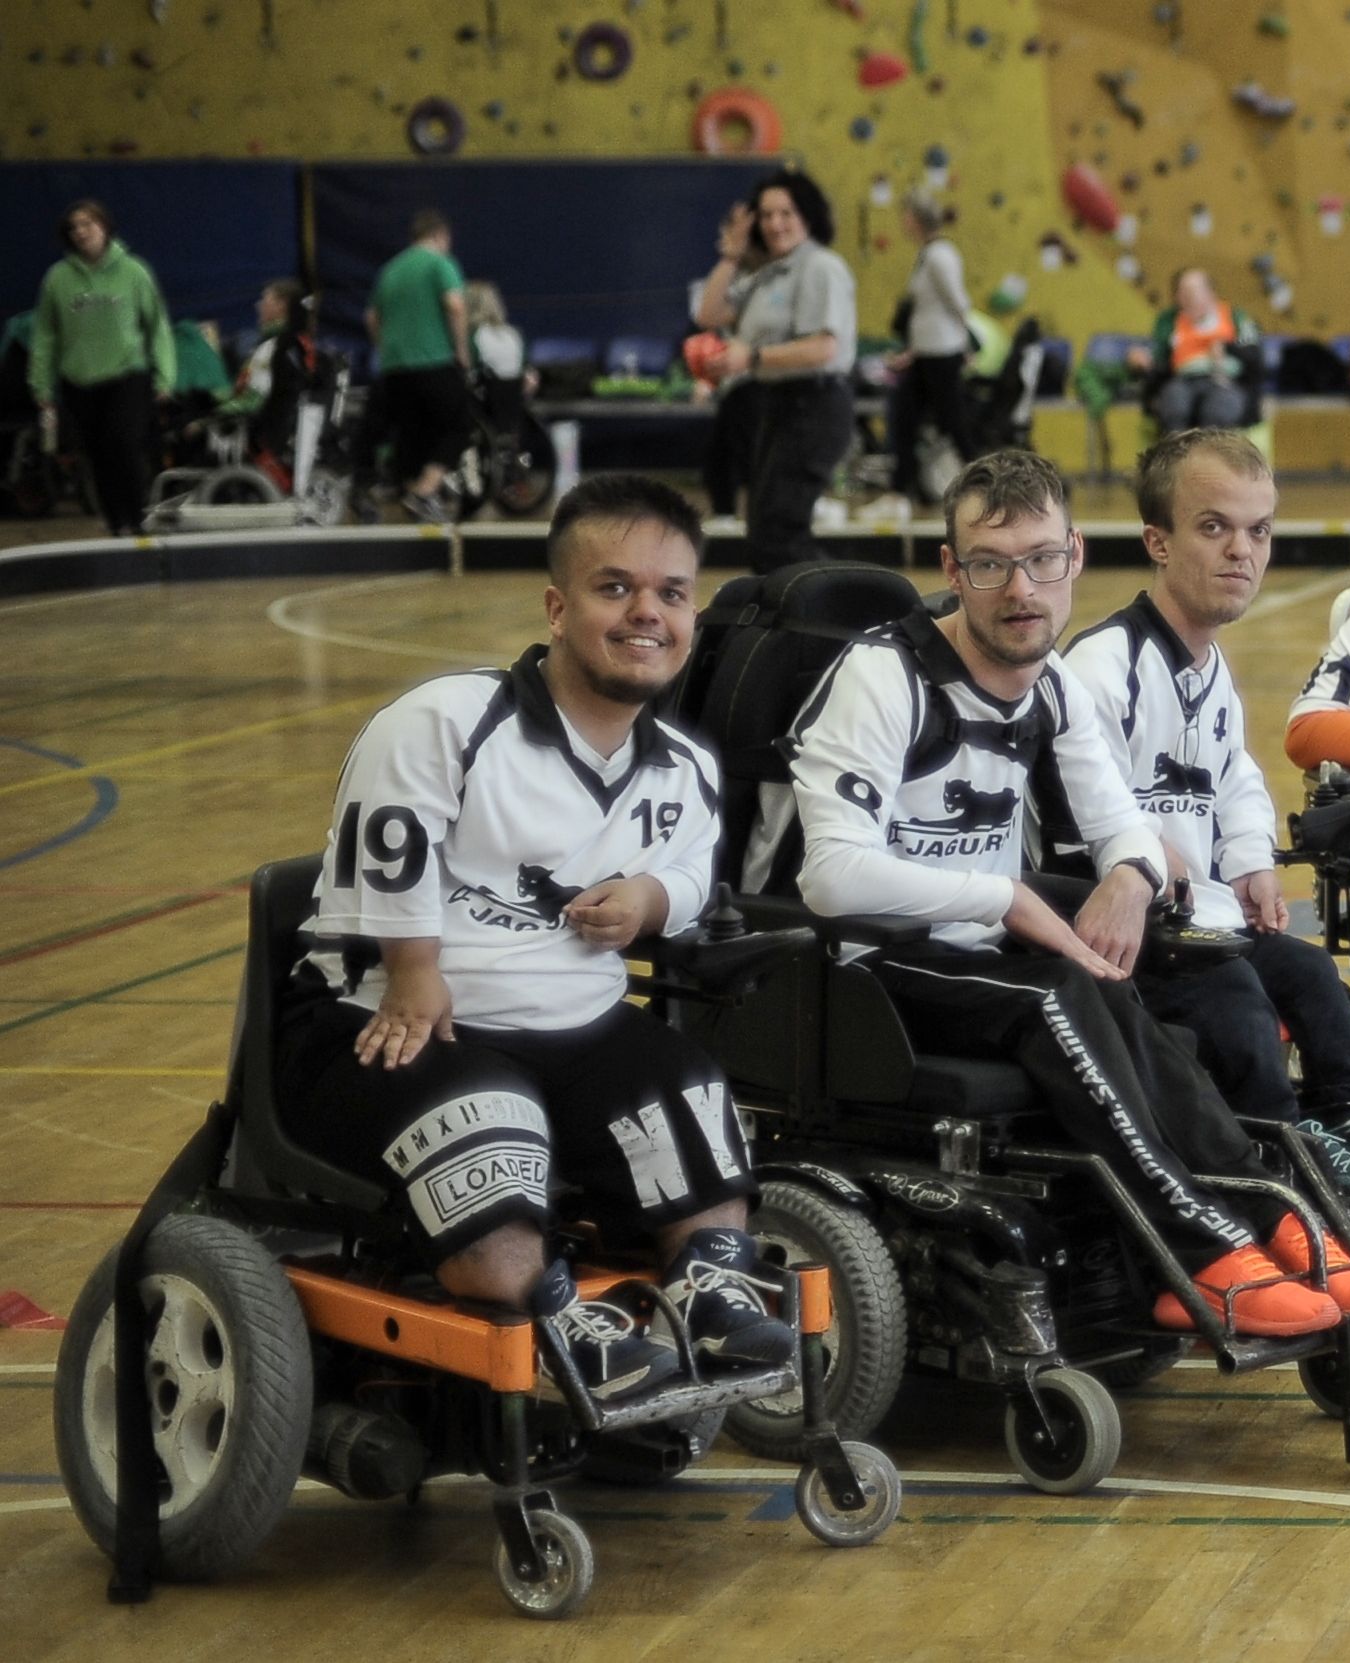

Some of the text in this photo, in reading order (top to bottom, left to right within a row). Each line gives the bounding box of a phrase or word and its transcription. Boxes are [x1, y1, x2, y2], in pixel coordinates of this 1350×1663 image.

[1213, 707, 1227, 742] 4
[334, 802, 428, 893] 19
[630, 798, 684, 849] 19
